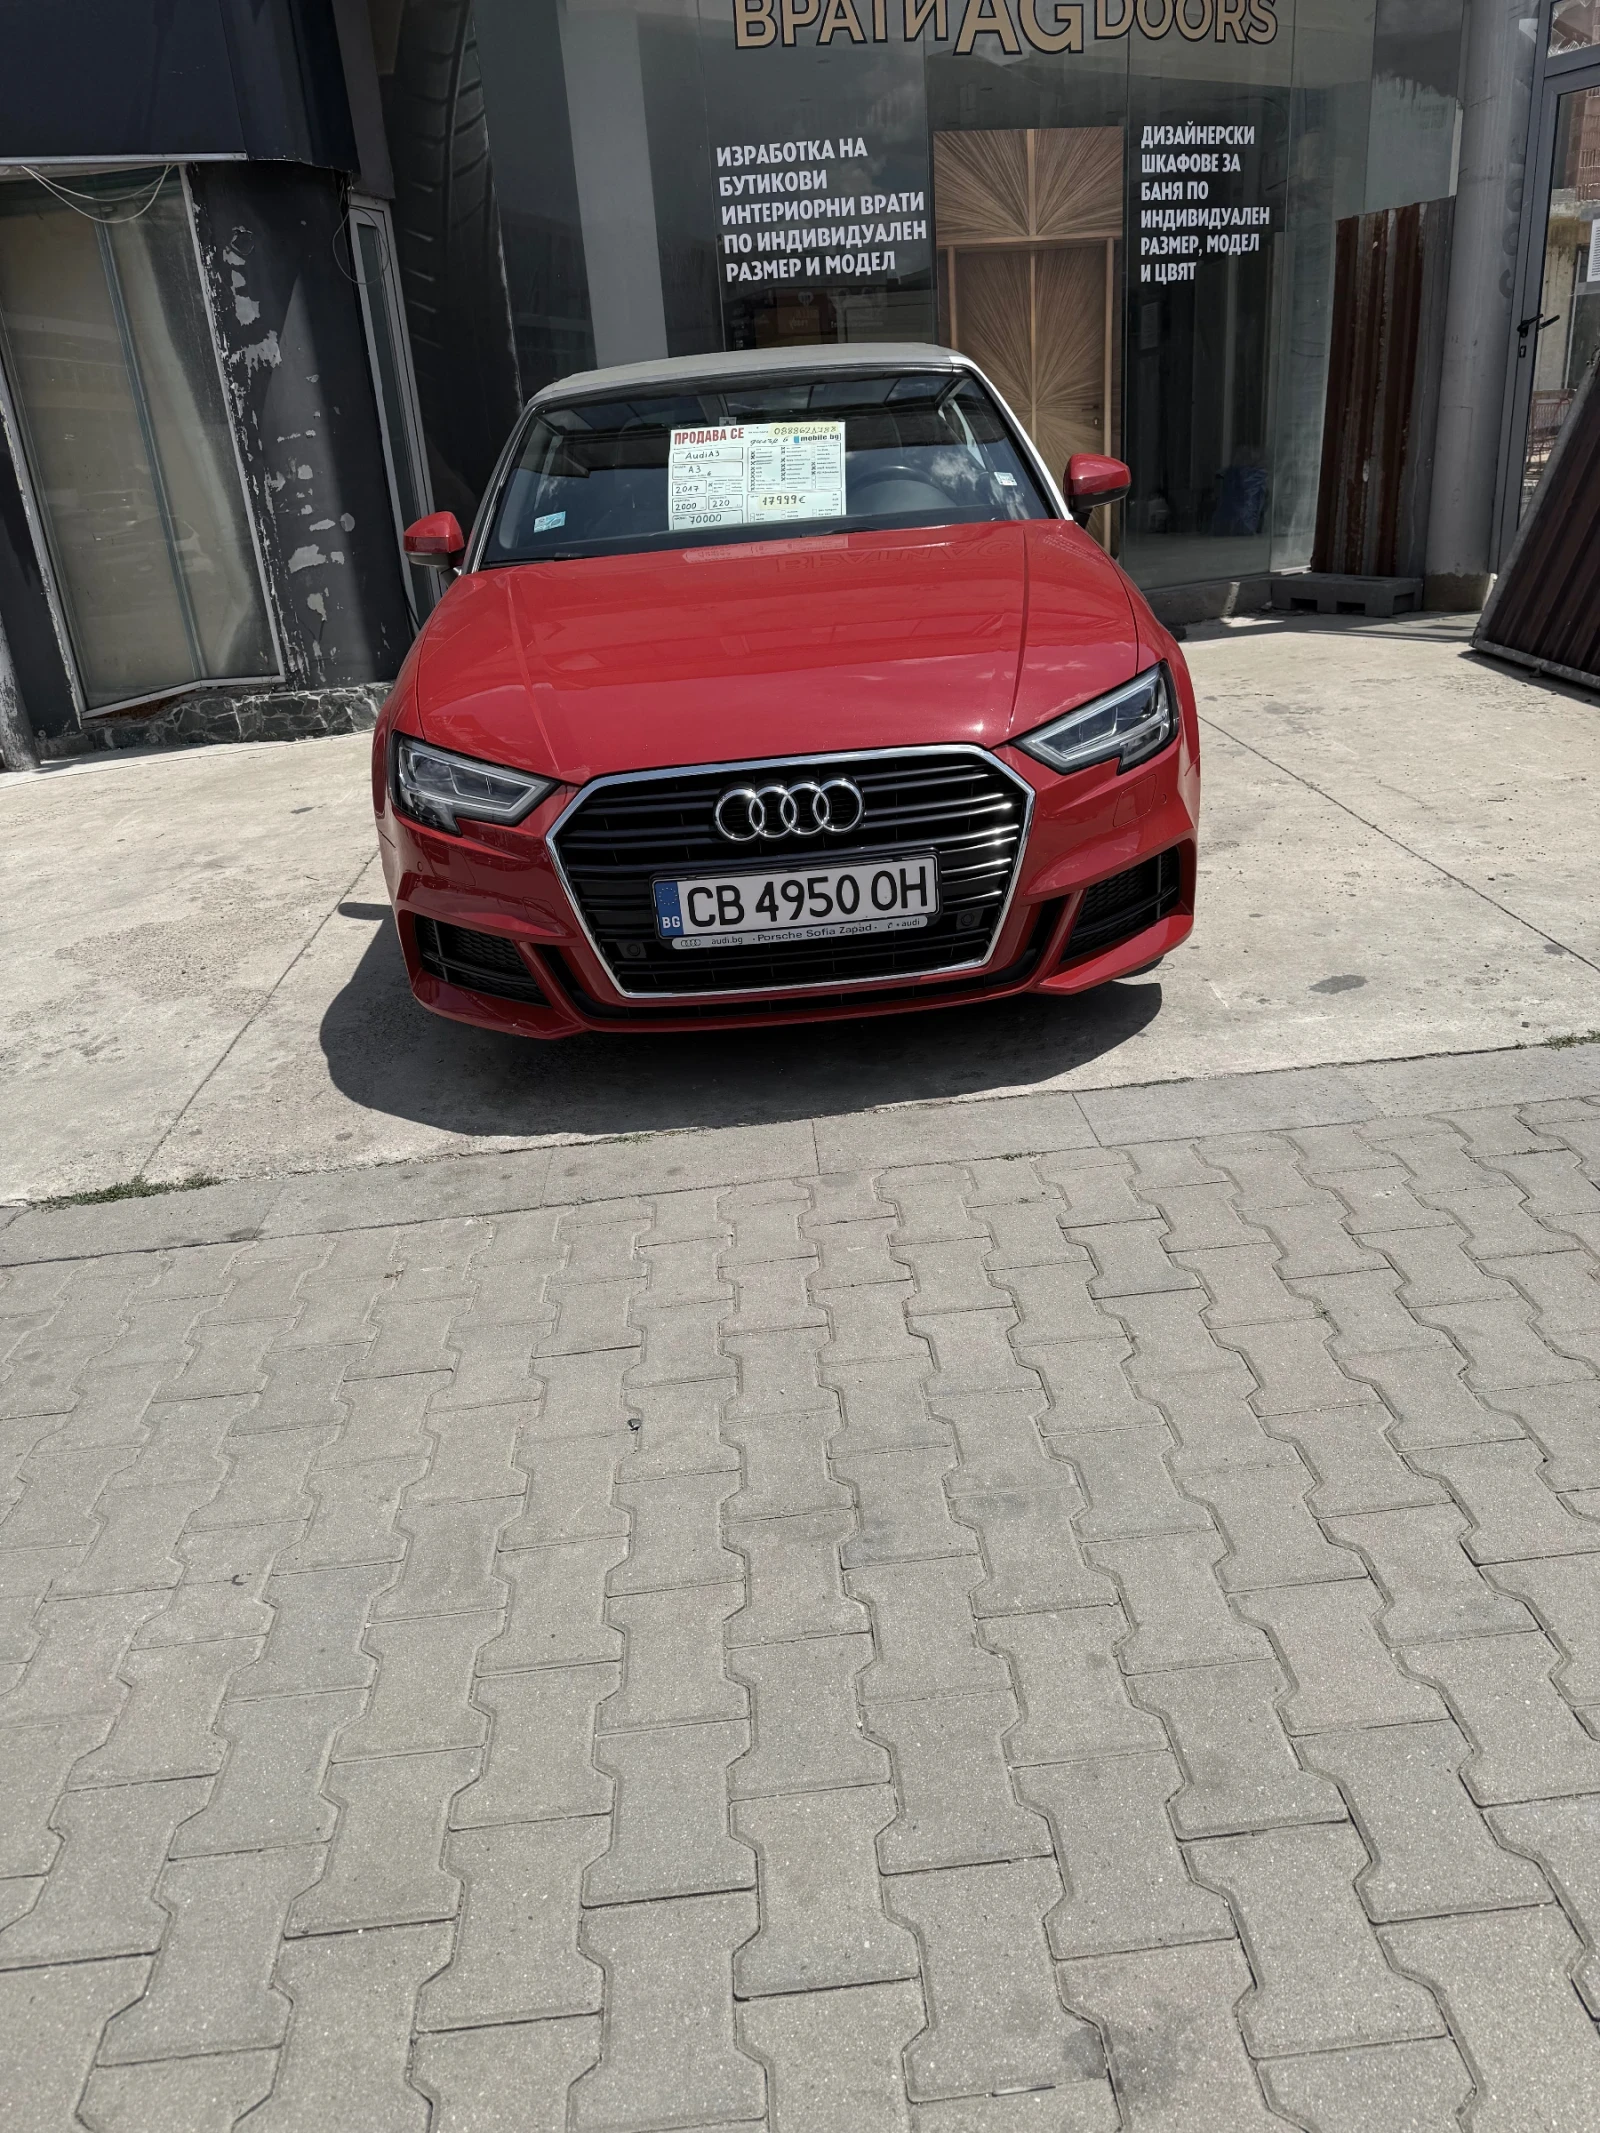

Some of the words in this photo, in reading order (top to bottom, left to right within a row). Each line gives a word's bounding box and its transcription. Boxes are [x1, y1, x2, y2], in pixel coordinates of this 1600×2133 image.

[952, 0, 1084, 56] AG
[1093, 0, 1278, 44] DOORS
[1141, 120, 1256, 149] ДИЗАЙНЕРСКИ
[716, 139, 835, 168] ИЗРАБОТКА
[838, 137, 868, 159] НА
[1141, 154, 1219, 174] ШКАФОВЕ
[1222, 153, 1241, 173] ЗА
[719, 169, 828, 196] БУТИКОВИ
[1141, 181, 1183, 202] БАНЯ
[1187, 180, 1209, 200] ПО
[721, 196, 856, 226] ИНТЕРИОРНИ
[860, 192, 925, 215] ВРАТИ
[1141, 207, 1271, 231] ИНДИВИДУАЛЕН
[723, 232, 753, 255] ПО
[756, 220, 928, 253] ИНДИВИДУАЛЕН
[1141, 236, 1203, 259] РАЗМЕР,
[1206, 233, 1261, 256] МОДЕЛ
[725, 258, 802, 283] РАЗМЕР
[806, 256, 822, 278] И
[825, 250, 896, 277] МОДЕЛ
[1141, 264, 1152, 283] И
[1155, 262, 1197, 285] ЦВЯТ
[674, 429, 727, 446] ПРОДАВА
[730, 427, 744, 440] СЕ
[675, 485, 700, 494] 2017
[675, 502, 697, 511] 2000
[712, 499, 730, 508] 220
[689, 514, 722, 525] 70000
[755, 874, 860, 922] 4950
[661, 916, 681, 929] BG
[711, 935, 743, 946] audi.bg
[757, 930, 803, 943] Porsche
[806, 927, 836, 938] Sofia
[839, 923, 872, 936] Zapad
